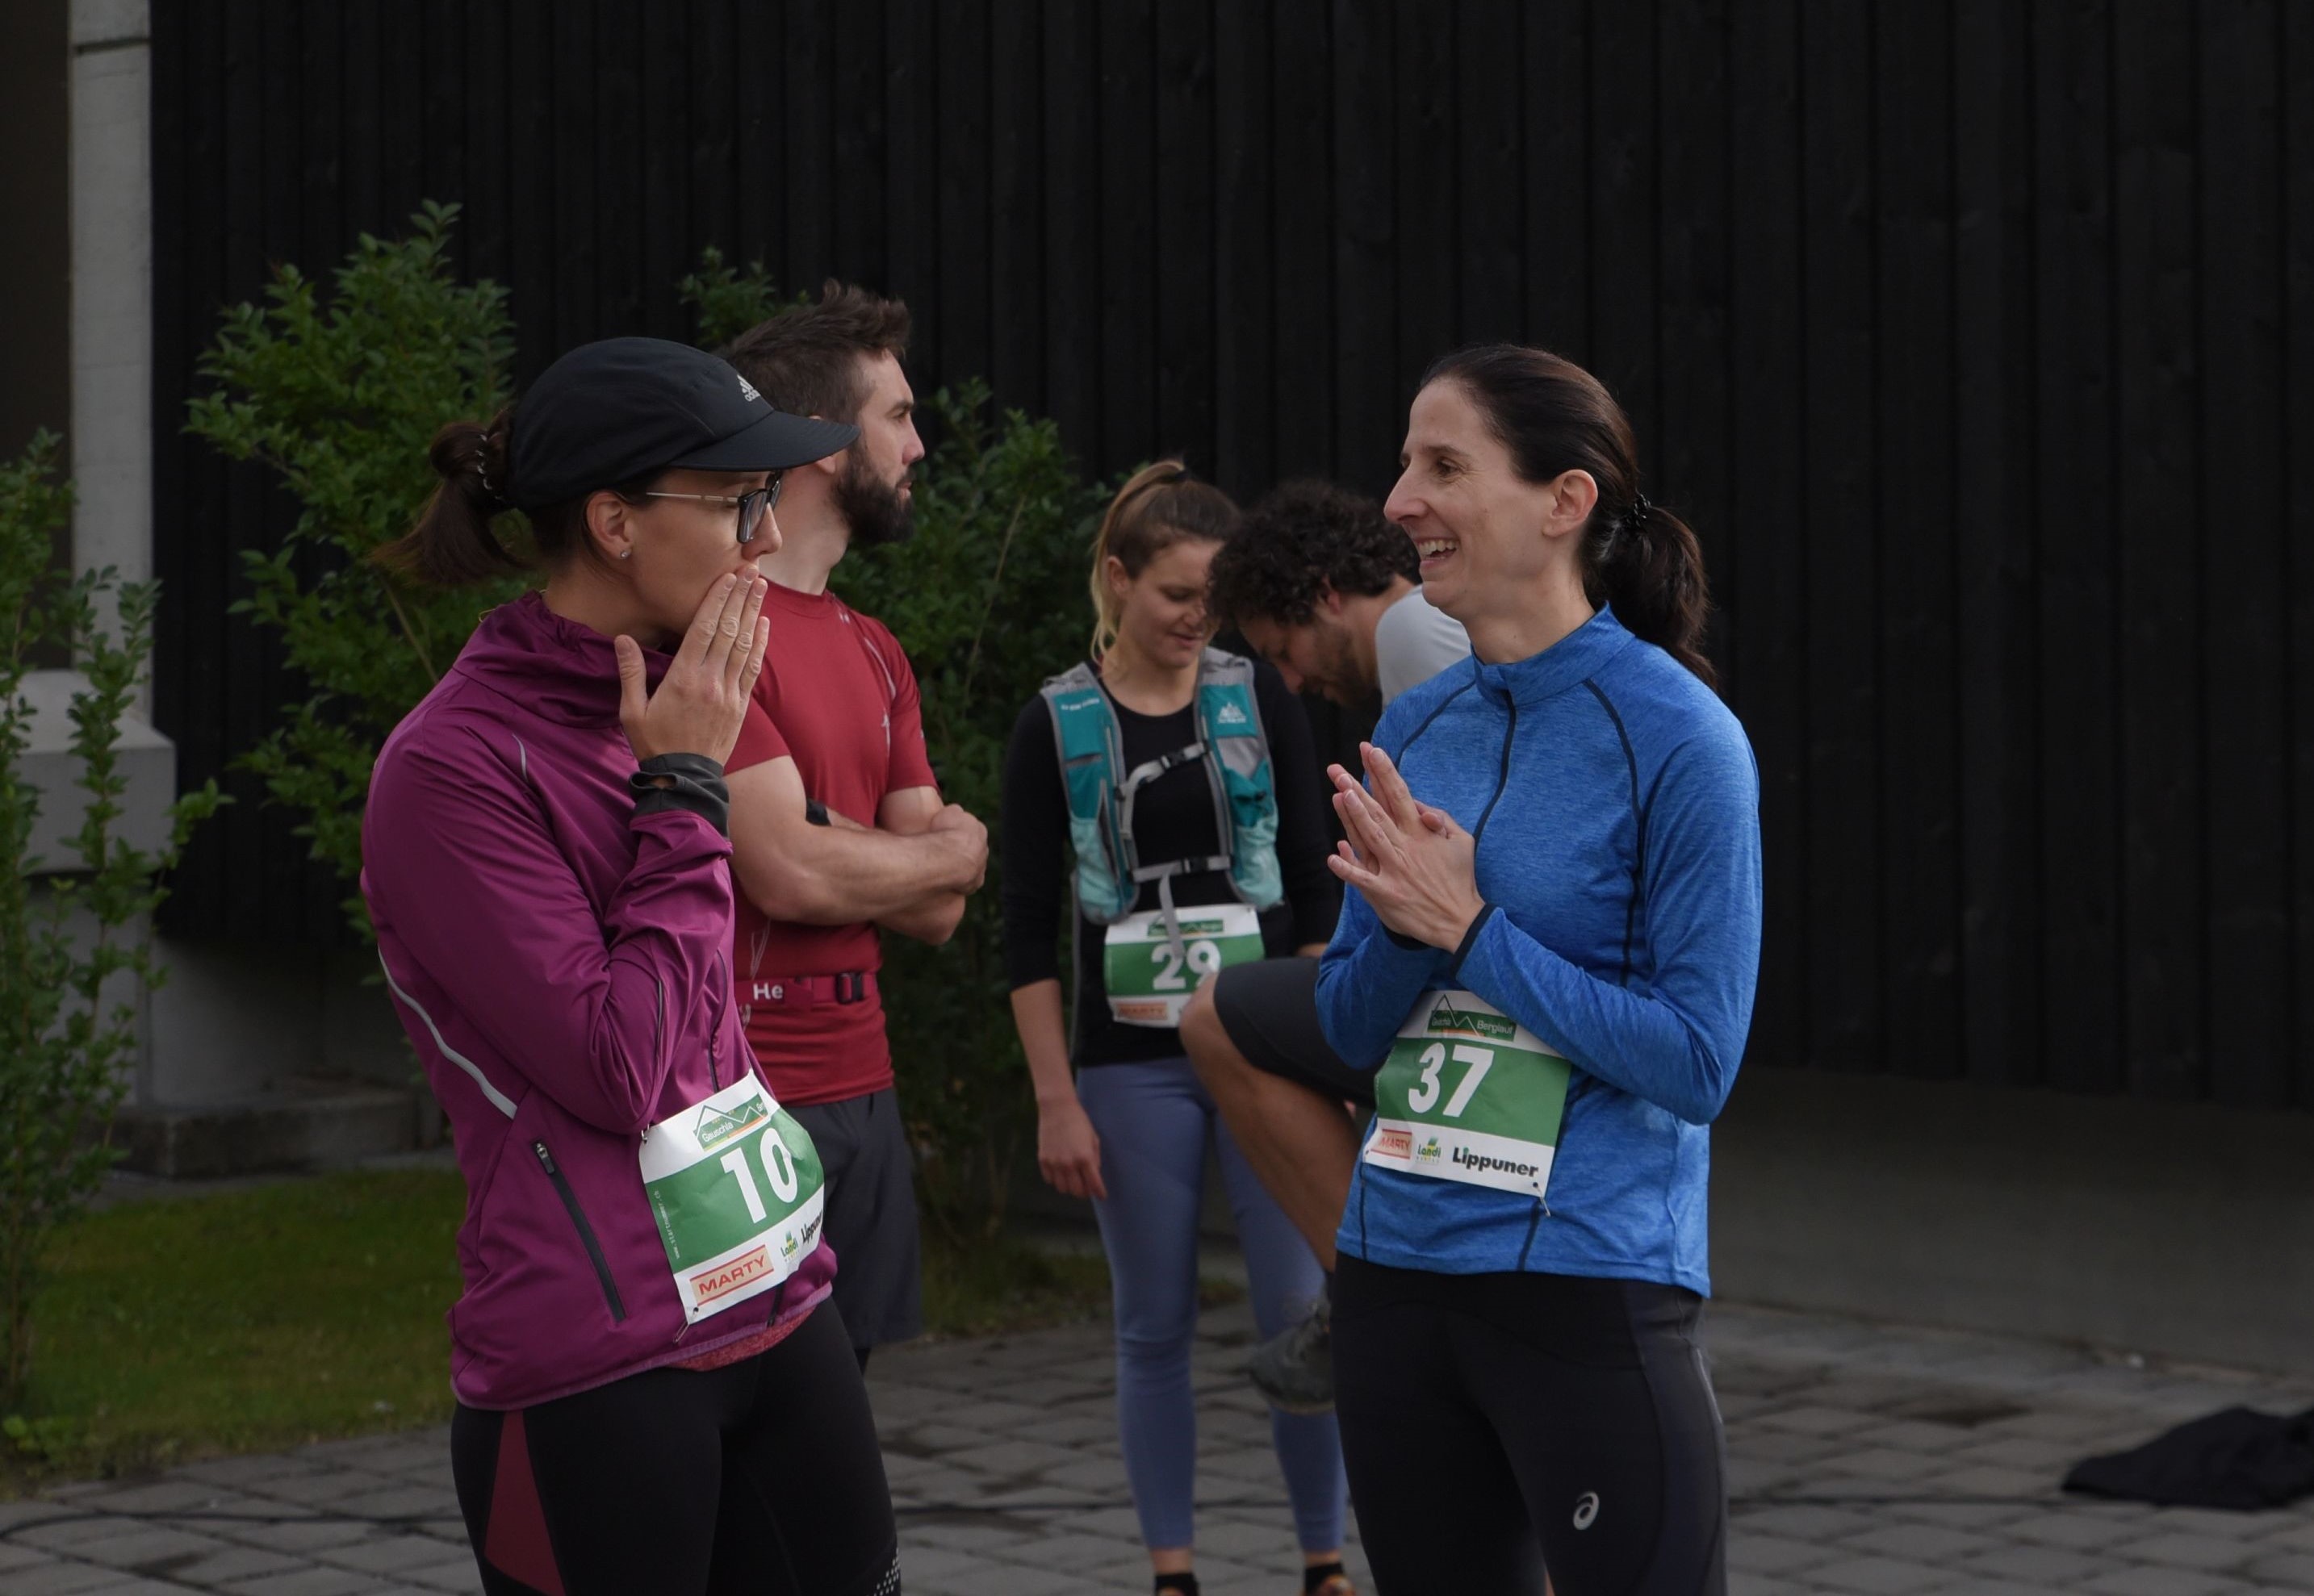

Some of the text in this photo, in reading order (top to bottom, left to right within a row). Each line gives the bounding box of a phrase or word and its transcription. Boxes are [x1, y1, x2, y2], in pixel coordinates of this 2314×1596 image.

[1151, 939, 1221, 990] 29
[753, 982, 784, 1001] He
[1476, 1020, 1513, 1034] Berglauf
[1408, 1042, 1495, 1118] 37
[1379, 1136, 1411, 1151] MARTY
[1417, 1143, 1442, 1159] Landi
[1452, 1146, 1539, 1177] Lippuner
[720, 1127, 798, 1224] 10
[780, 1236, 799, 1258] Landi
[698, 1254, 765, 1296] MARTY
